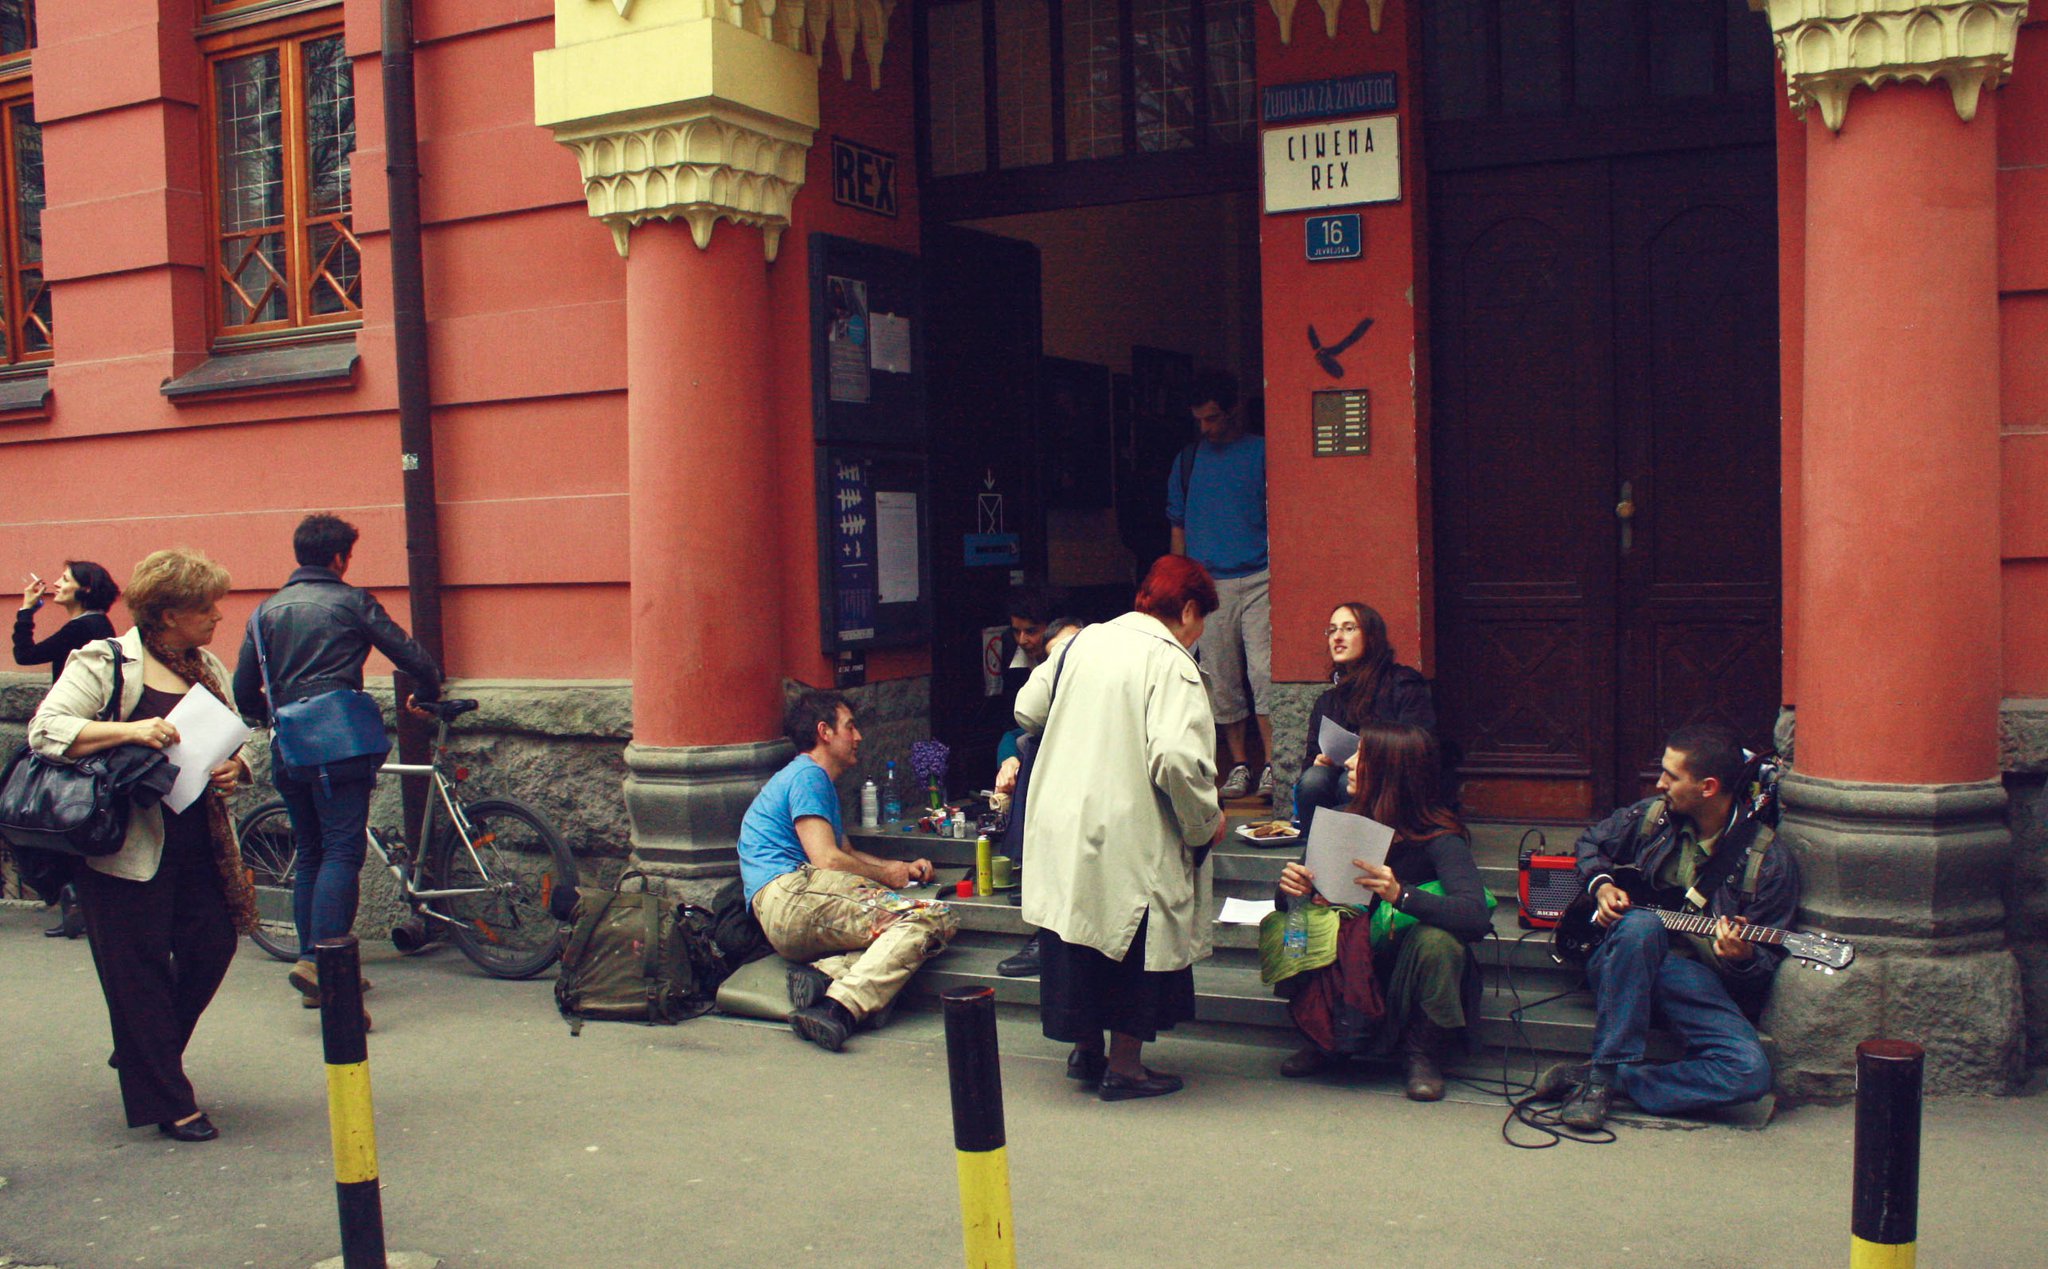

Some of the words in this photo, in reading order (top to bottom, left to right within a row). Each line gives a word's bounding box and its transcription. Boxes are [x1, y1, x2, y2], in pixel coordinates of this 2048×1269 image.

[1288, 127, 1374, 161] CINEMA
[836, 144, 896, 211] REX
[1311, 161, 1349, 191] REX
[1321, 220, 1343, 245] 16
